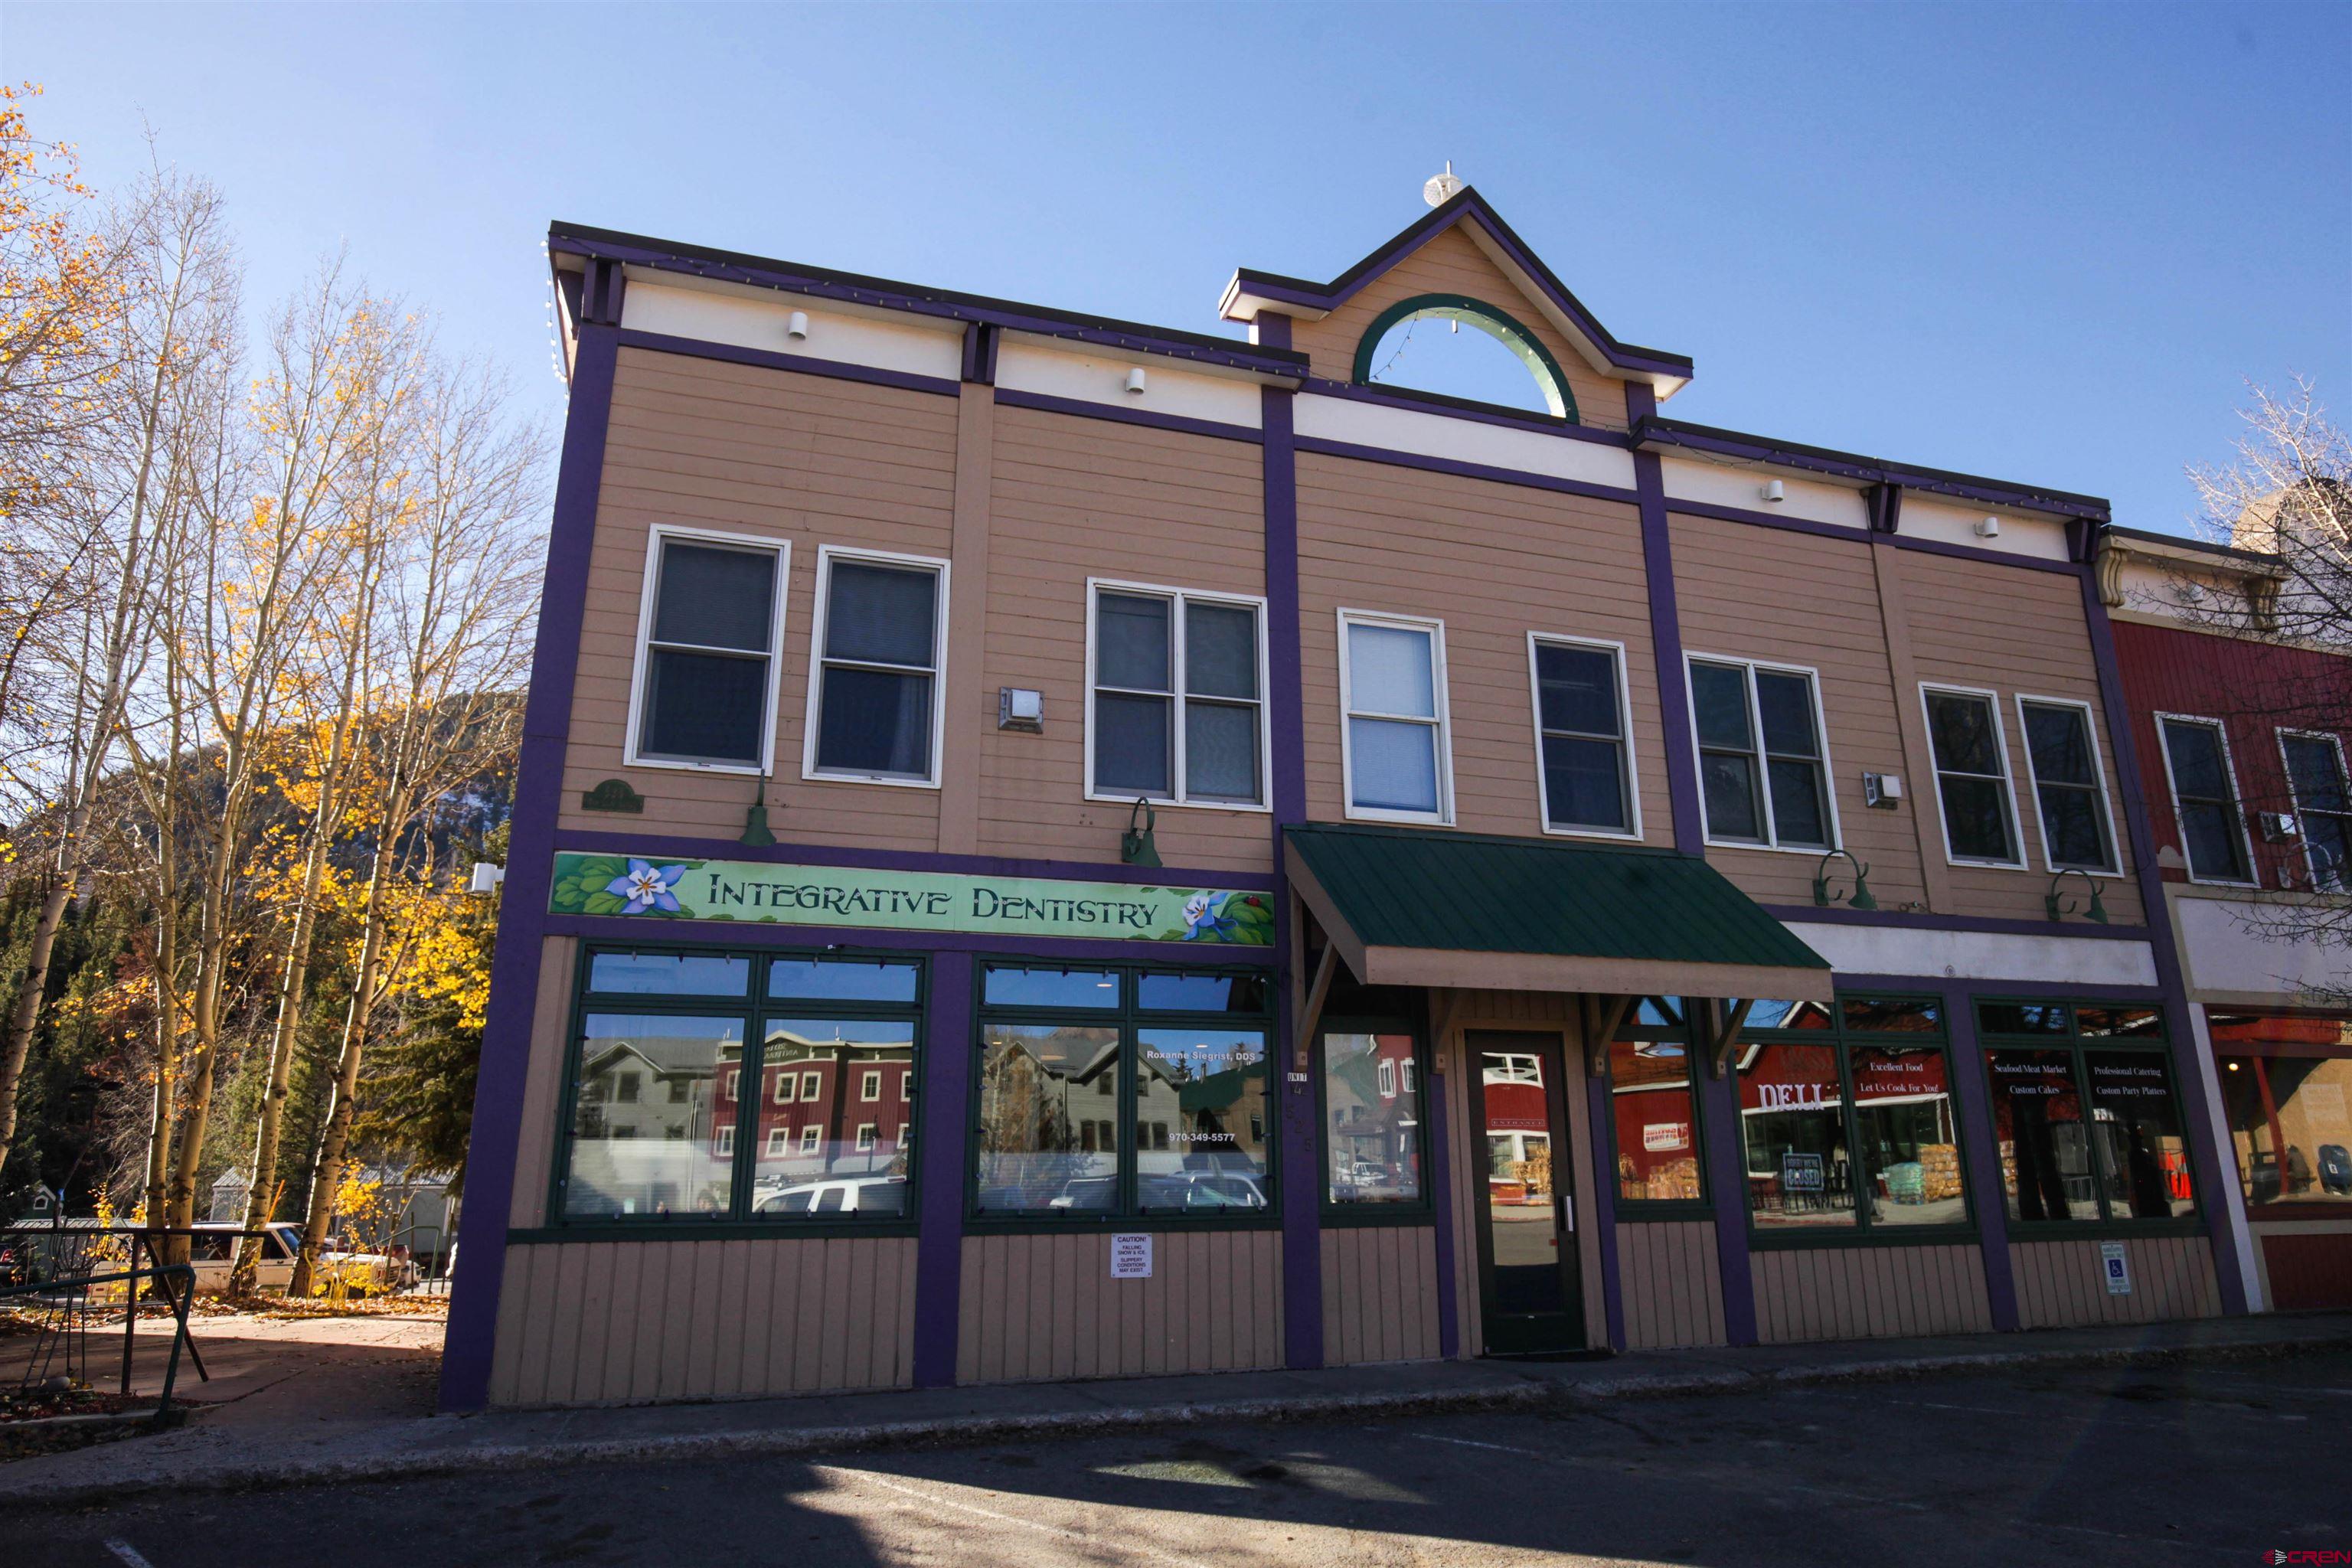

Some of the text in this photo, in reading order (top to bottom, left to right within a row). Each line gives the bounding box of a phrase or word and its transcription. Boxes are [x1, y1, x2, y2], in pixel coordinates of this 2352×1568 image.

[707, 873, 1159, 929] INTEGRATIVE DENTISTRY
[1146, 1050, 1256, 1062] Roxanne Siegrist, DDS
[1870, 1062, 1924, 1072] Excellent Food
[2042, 1064, 2067, 1073] Market
[1288, 1073, 1307, 1081] UNIT
[2094, 1067, 2161, 1078] Professional Catering
[1860, 1083, 1939, 1093] Let Us Cook For You!
[2009, 1085, 2060, 1094] Custom Cakes
[2096, 1086, 2167, 1096] Custom Party Platters
[1757, 1083, 1824, 1111] DELI
[1168, 1133, 1236, 1142] 970-349-5577
[1788, 1168, 1820, 1185] CLOSED
